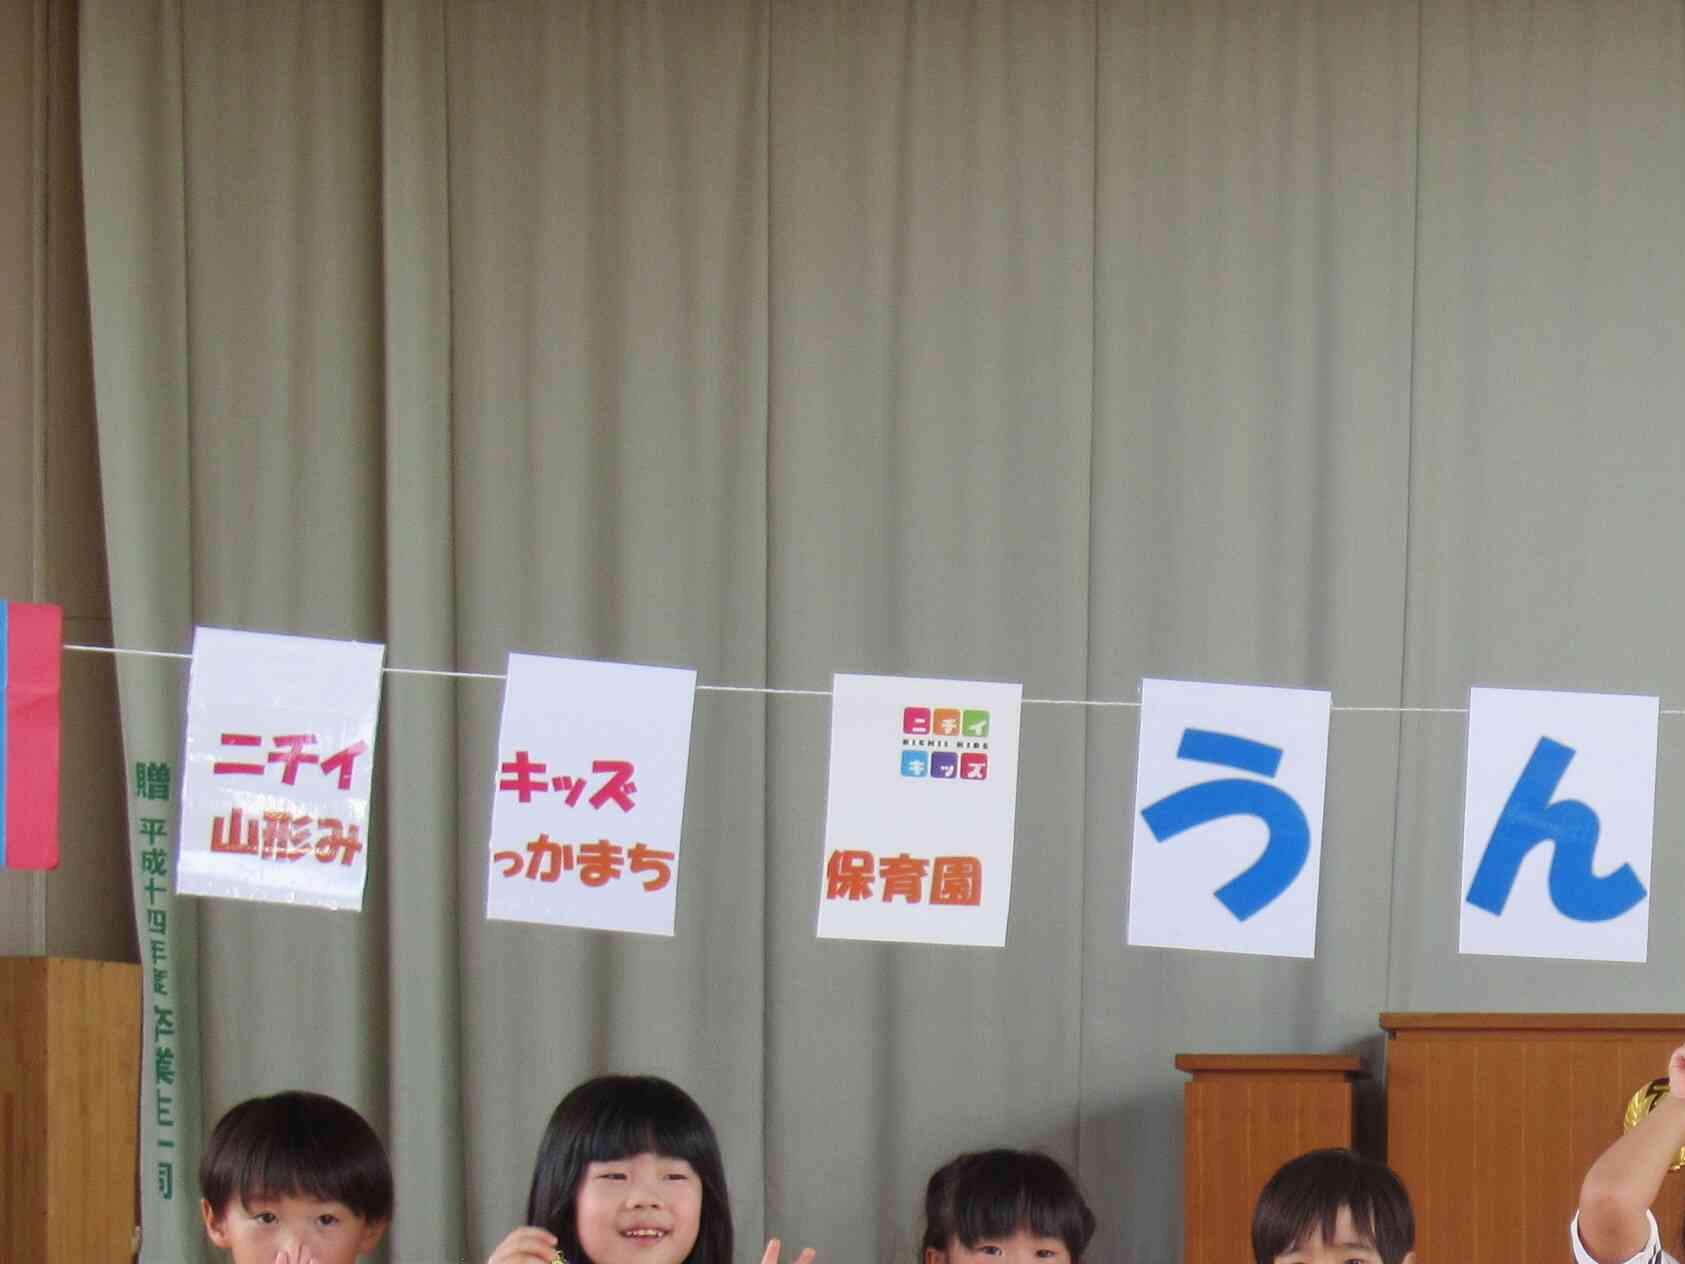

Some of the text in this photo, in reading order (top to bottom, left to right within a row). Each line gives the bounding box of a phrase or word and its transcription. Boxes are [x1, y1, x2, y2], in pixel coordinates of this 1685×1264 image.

[136, 762, 171, 801] 贈
[213, 733, 638, 813] ニチイ キッズ
[210, 807, 363, 867] 山形み
[826, 849, 983, 907] 保育園
